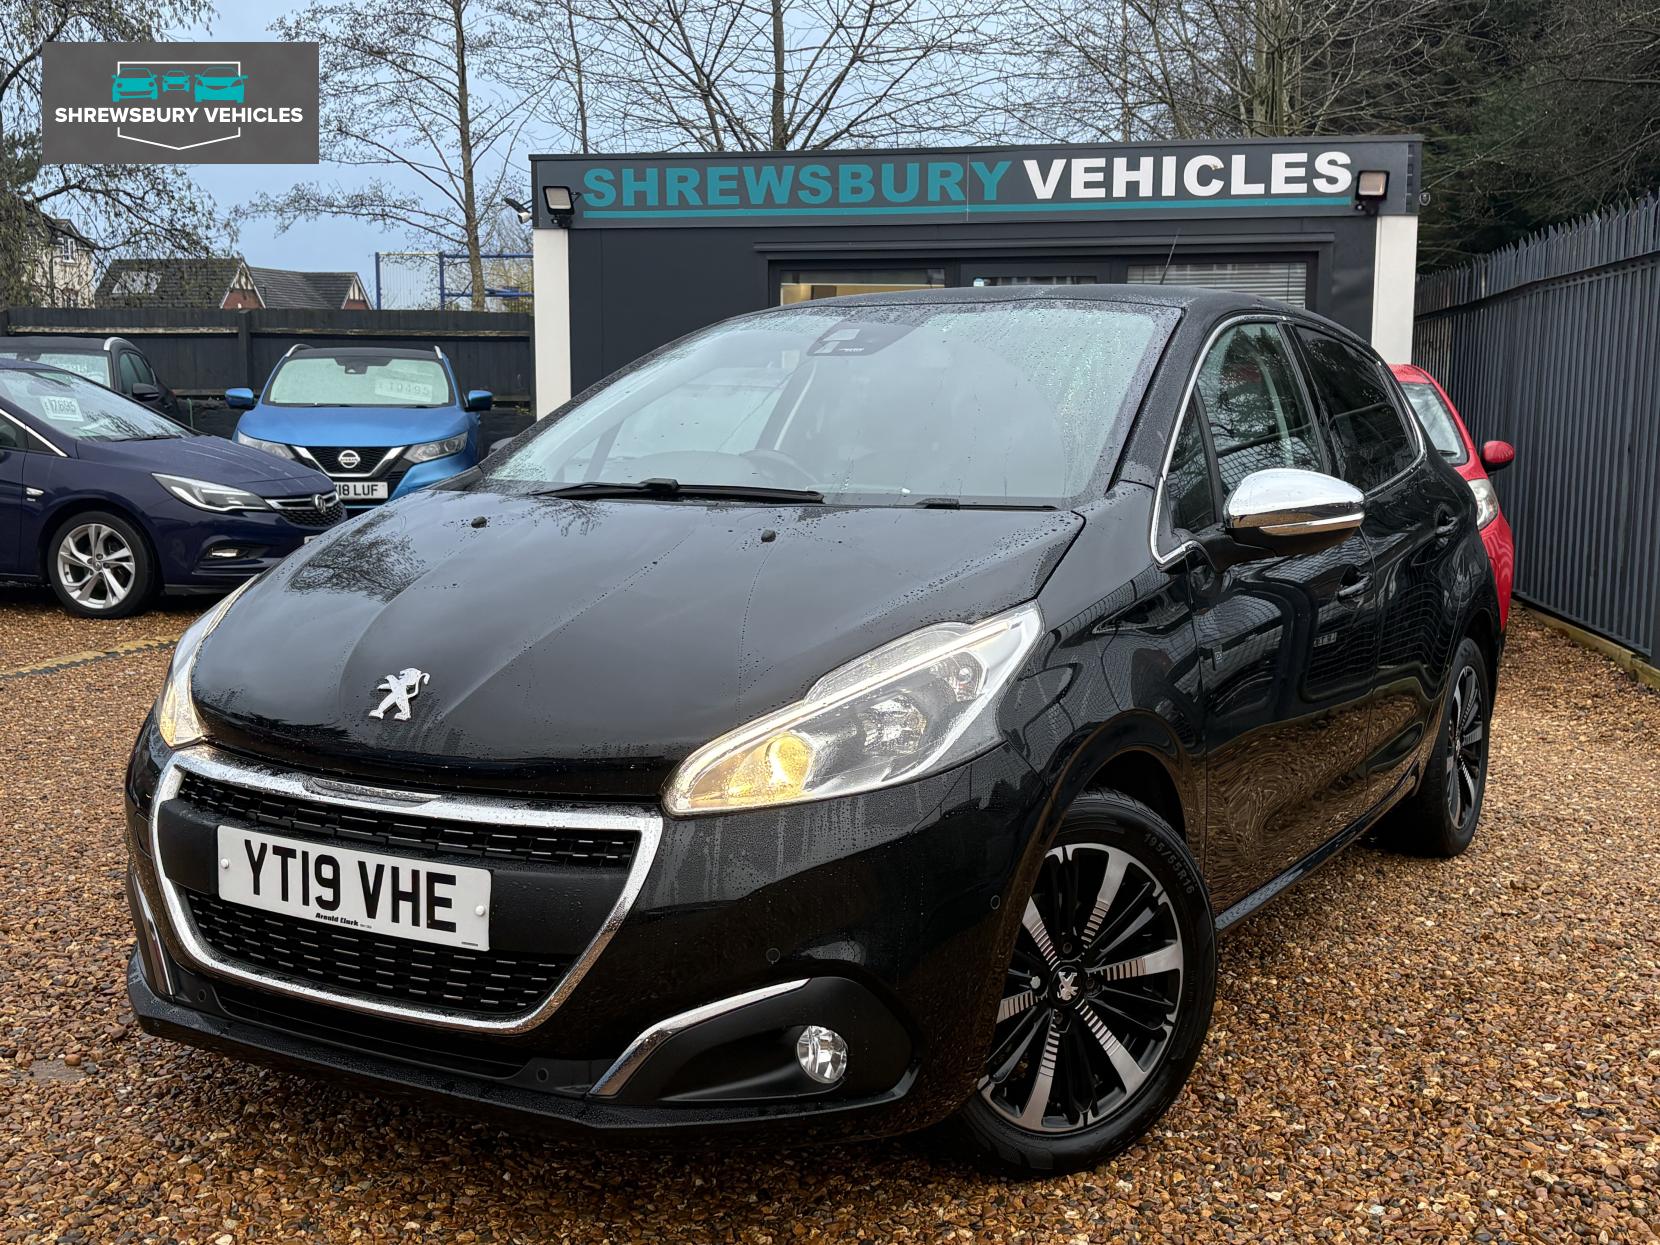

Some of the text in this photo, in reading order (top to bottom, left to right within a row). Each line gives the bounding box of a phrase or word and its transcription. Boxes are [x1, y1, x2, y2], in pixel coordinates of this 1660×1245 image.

[583, 151, 1353, 207] SHREWSBURY VEHICLES
[353, 484, 378, 496] LUF
[244, 838, 457, 934] YT19 VHE
